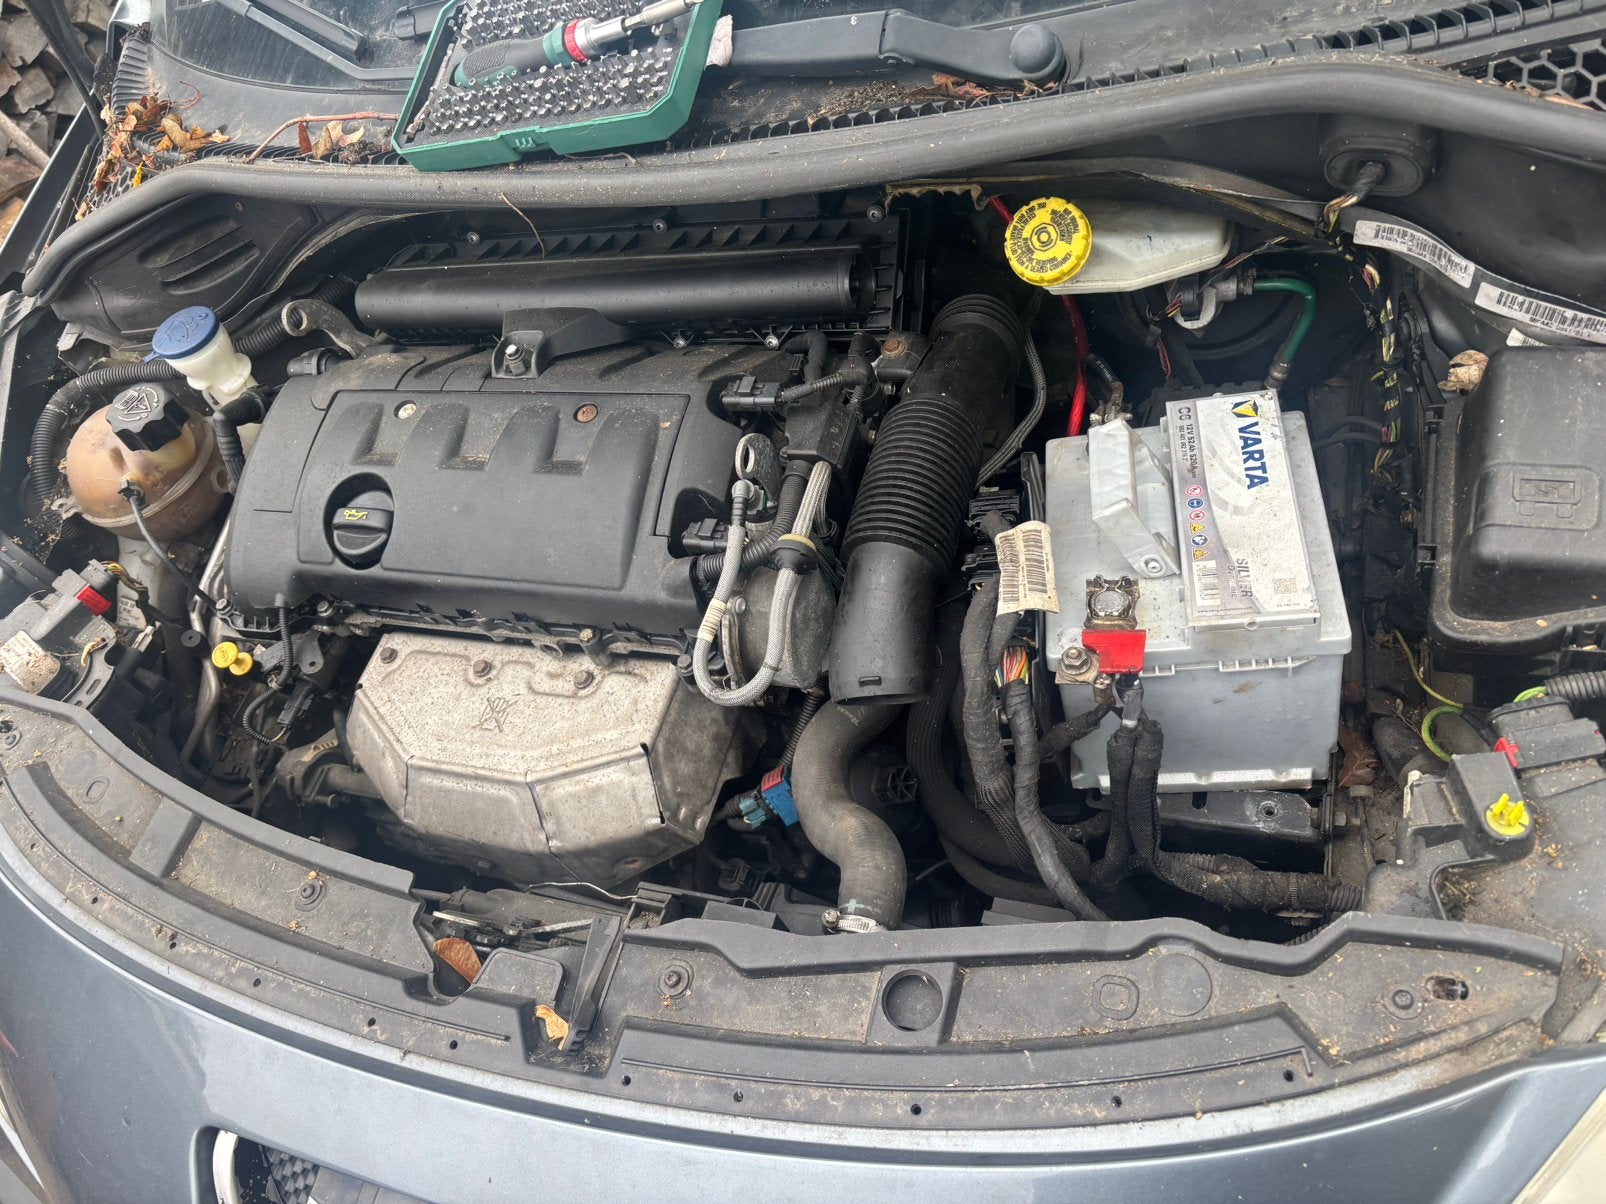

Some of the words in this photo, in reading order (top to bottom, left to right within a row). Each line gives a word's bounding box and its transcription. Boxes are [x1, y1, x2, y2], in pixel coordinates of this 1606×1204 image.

[1026, 206, 1036, 214] ONLY
[1036, 202, 1047, 210] USE
[1023, 212, 1036, 225] CLEAN
[1010, 225, 1018, 241] BRAKE
[1016, 224, 1024, 238] FILLER
[1010, 243, 1018, 255] FLUID
[1015, 255, 1025, 266] FROM
[1030, 265, 1048, 273] SEALED
[1178, 407, 1191, 421] C6
[1186, 424, 1194, 435] 12V
[1188, 436, 1196, 453] 52Ah
[1238, 421, 1269, 489] VARTA
[1237, 558, 1253, 598] SILVER
